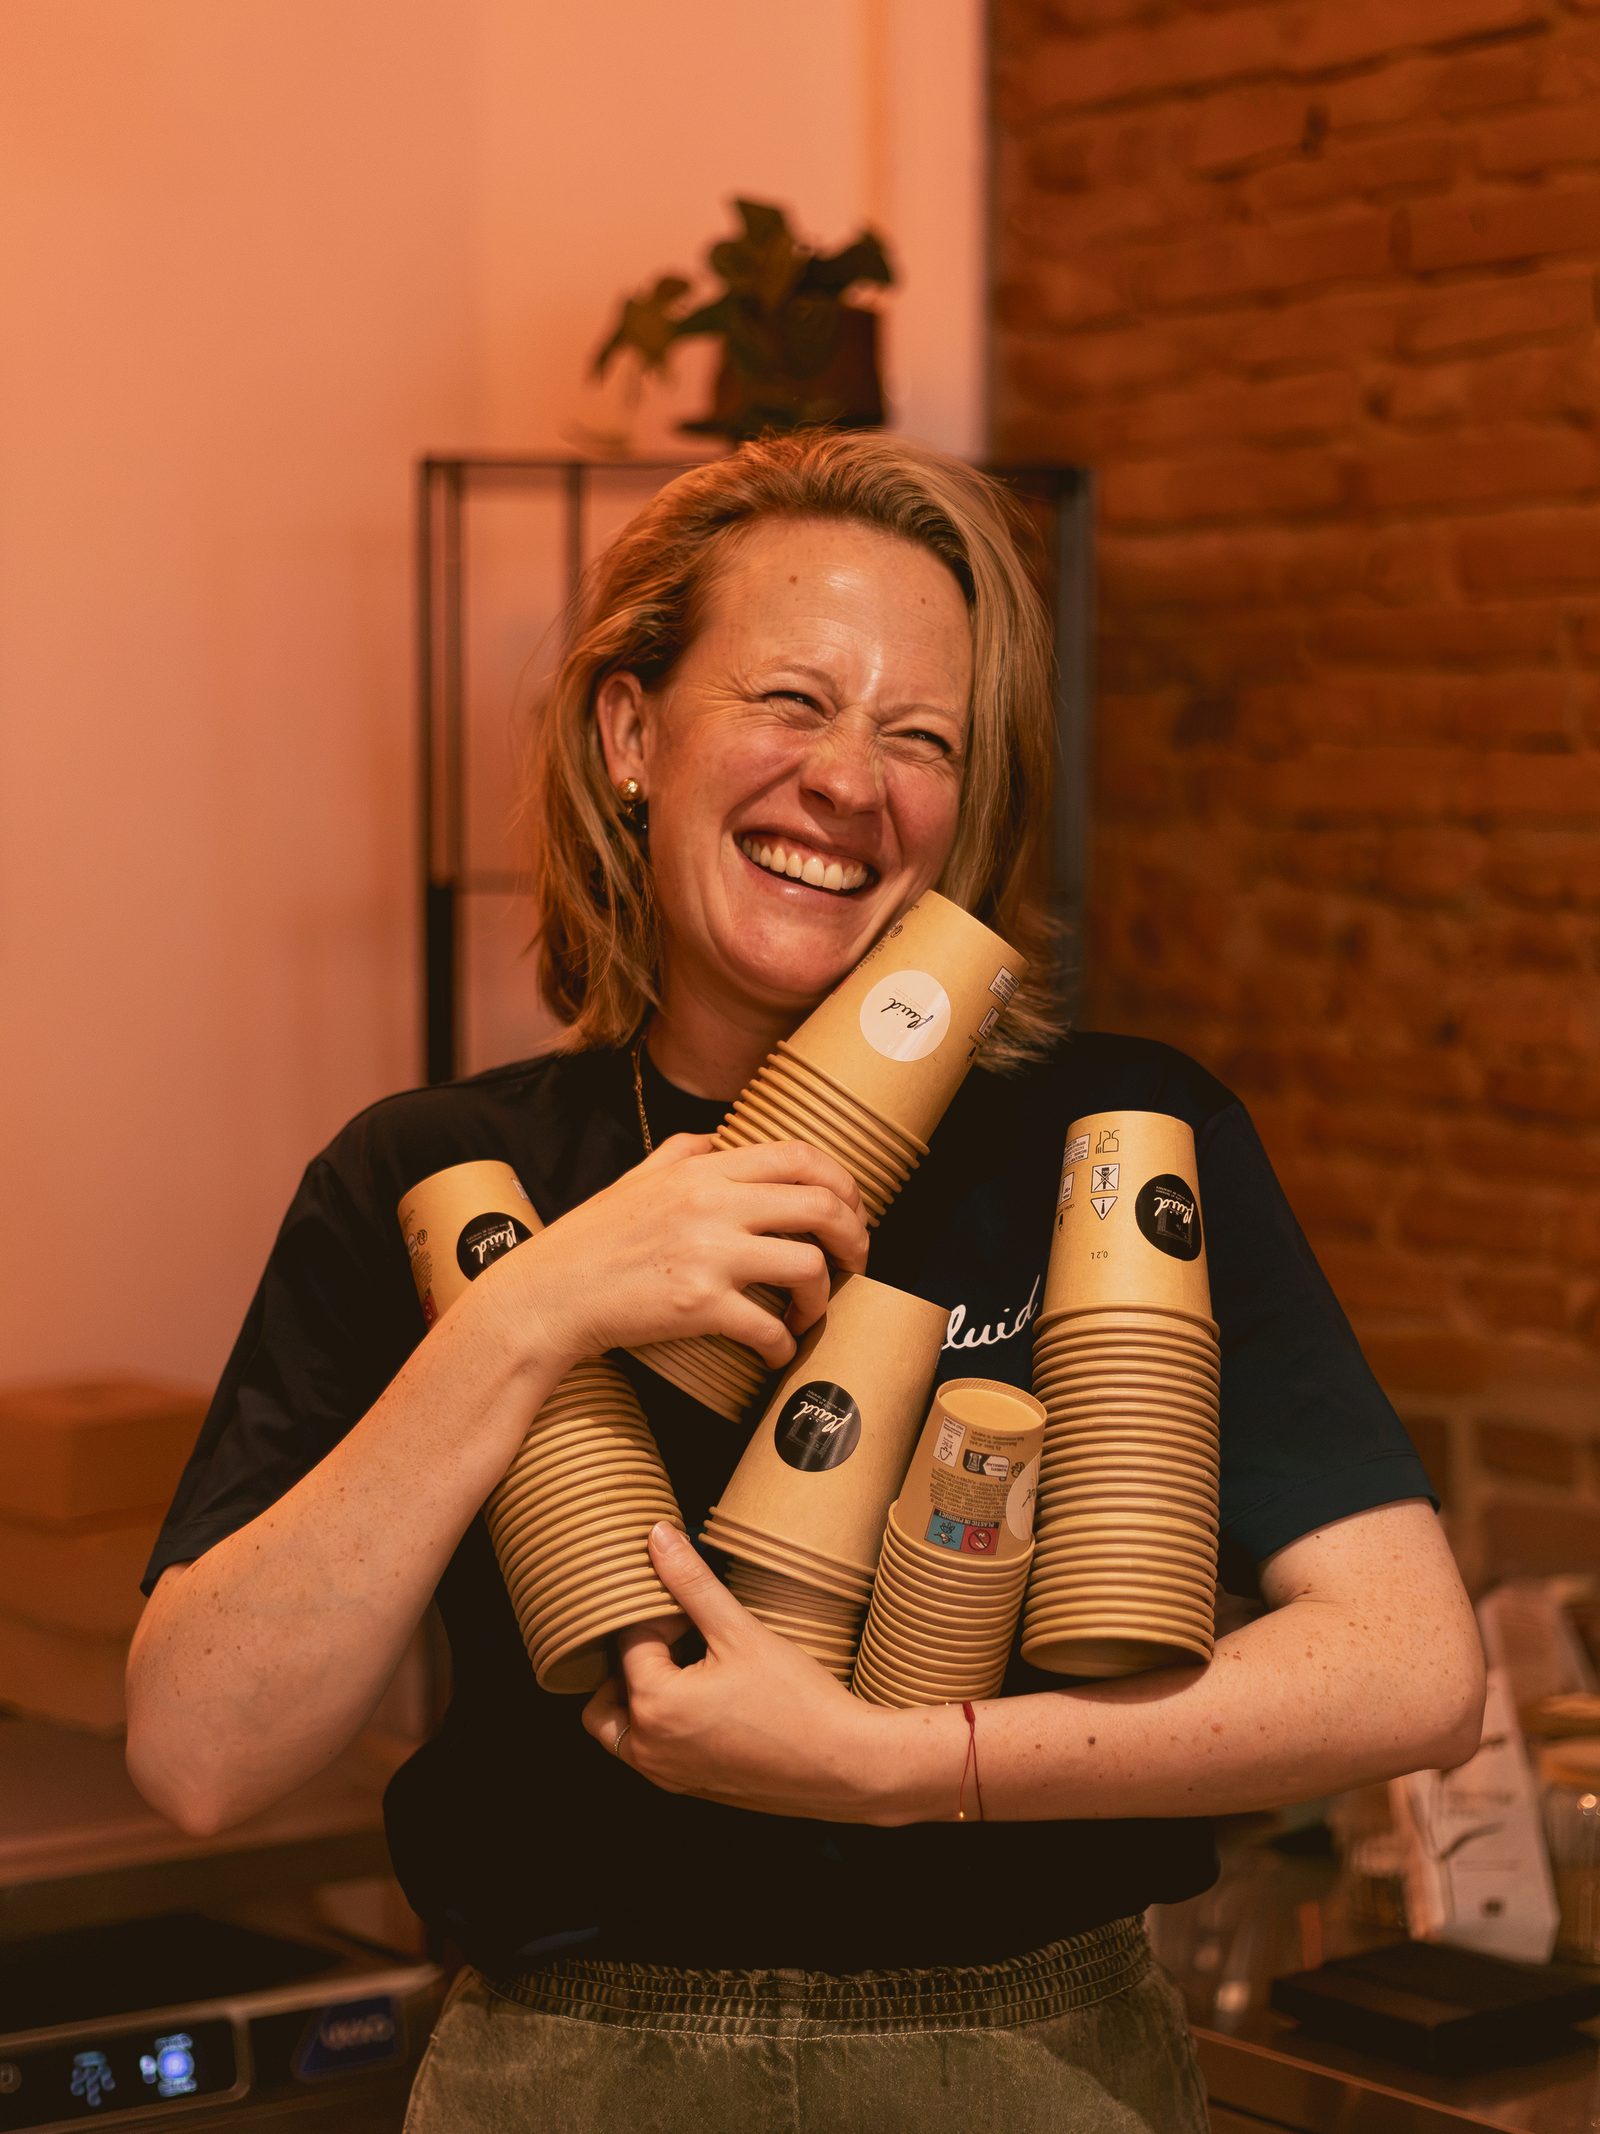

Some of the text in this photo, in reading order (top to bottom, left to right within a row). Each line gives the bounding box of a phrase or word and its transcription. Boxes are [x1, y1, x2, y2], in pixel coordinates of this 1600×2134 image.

[880, 997, 934, 1031] fluid
[1153, 1197, 1194, 1224] fluid
[471, 1220, 517, 1264] fluid
[940, 1273, 1040, 1350] luid
[792, 1401, 853, 1434] fluid
[938, 1511, 965, 1523] PRODUCT
